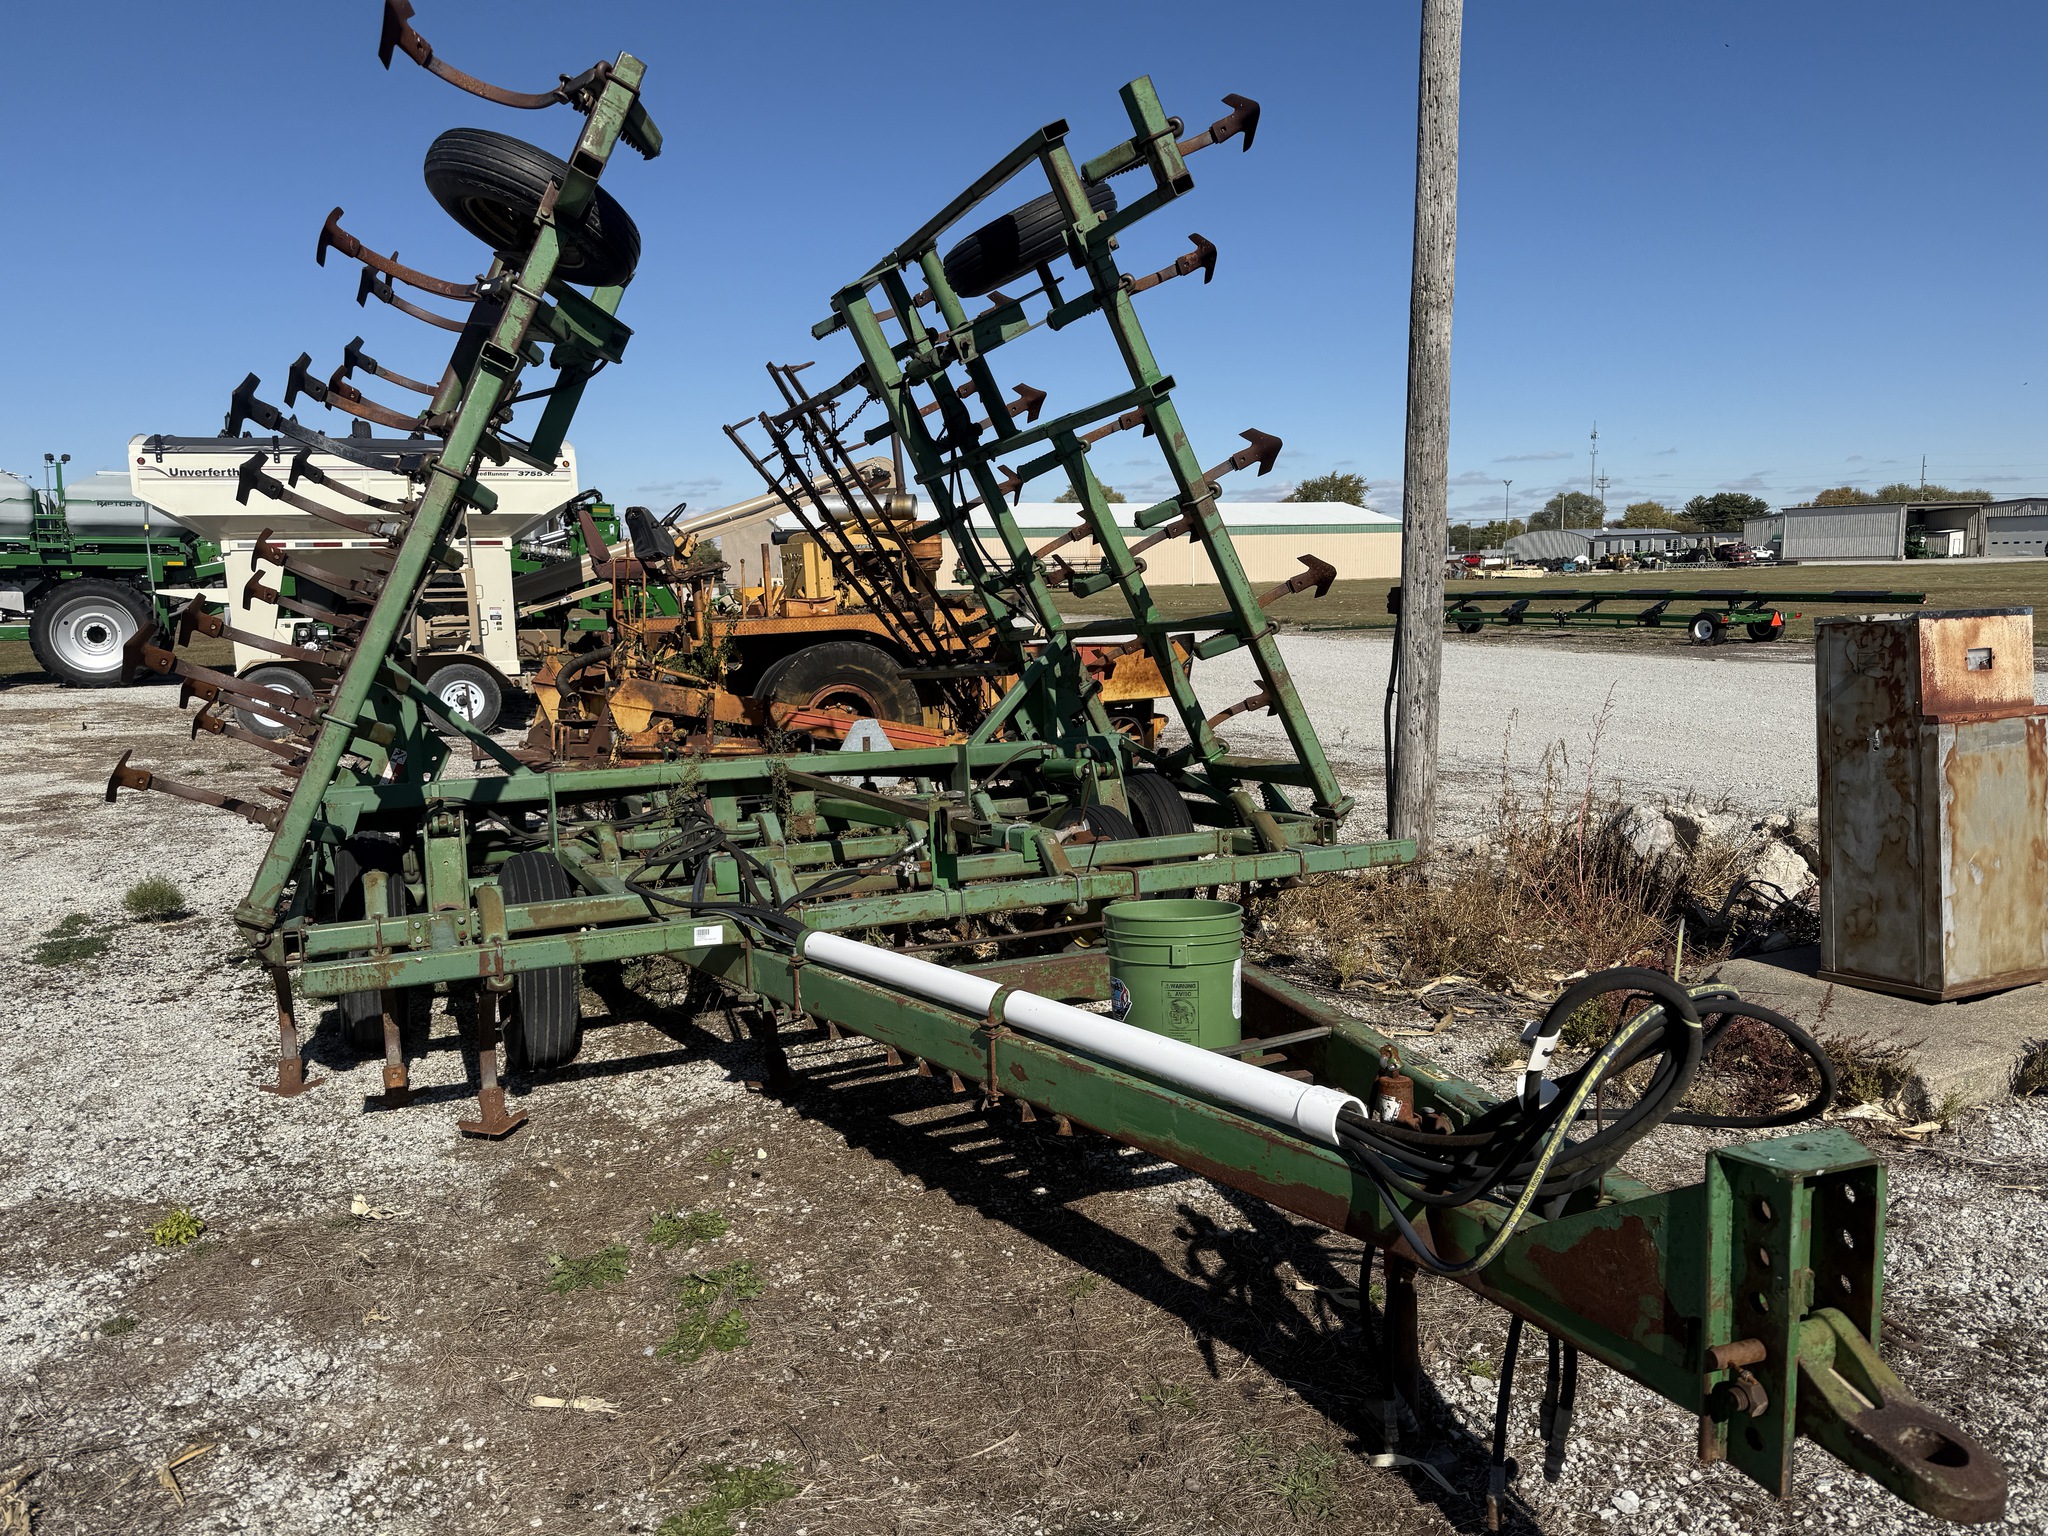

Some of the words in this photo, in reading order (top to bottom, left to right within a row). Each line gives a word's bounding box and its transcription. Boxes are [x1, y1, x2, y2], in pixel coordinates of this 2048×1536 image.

[169, 467, 240, 477] Unverferth
[96, 500, 133, 508] RAPTOR
[1539, 1157, 1550, 1171] PSI)
[1530, 1170, 1543, 1189] (6000
[1522, 1188, 1534, 1203] MPa
[1519, 1202, 1526, 1211] 42
